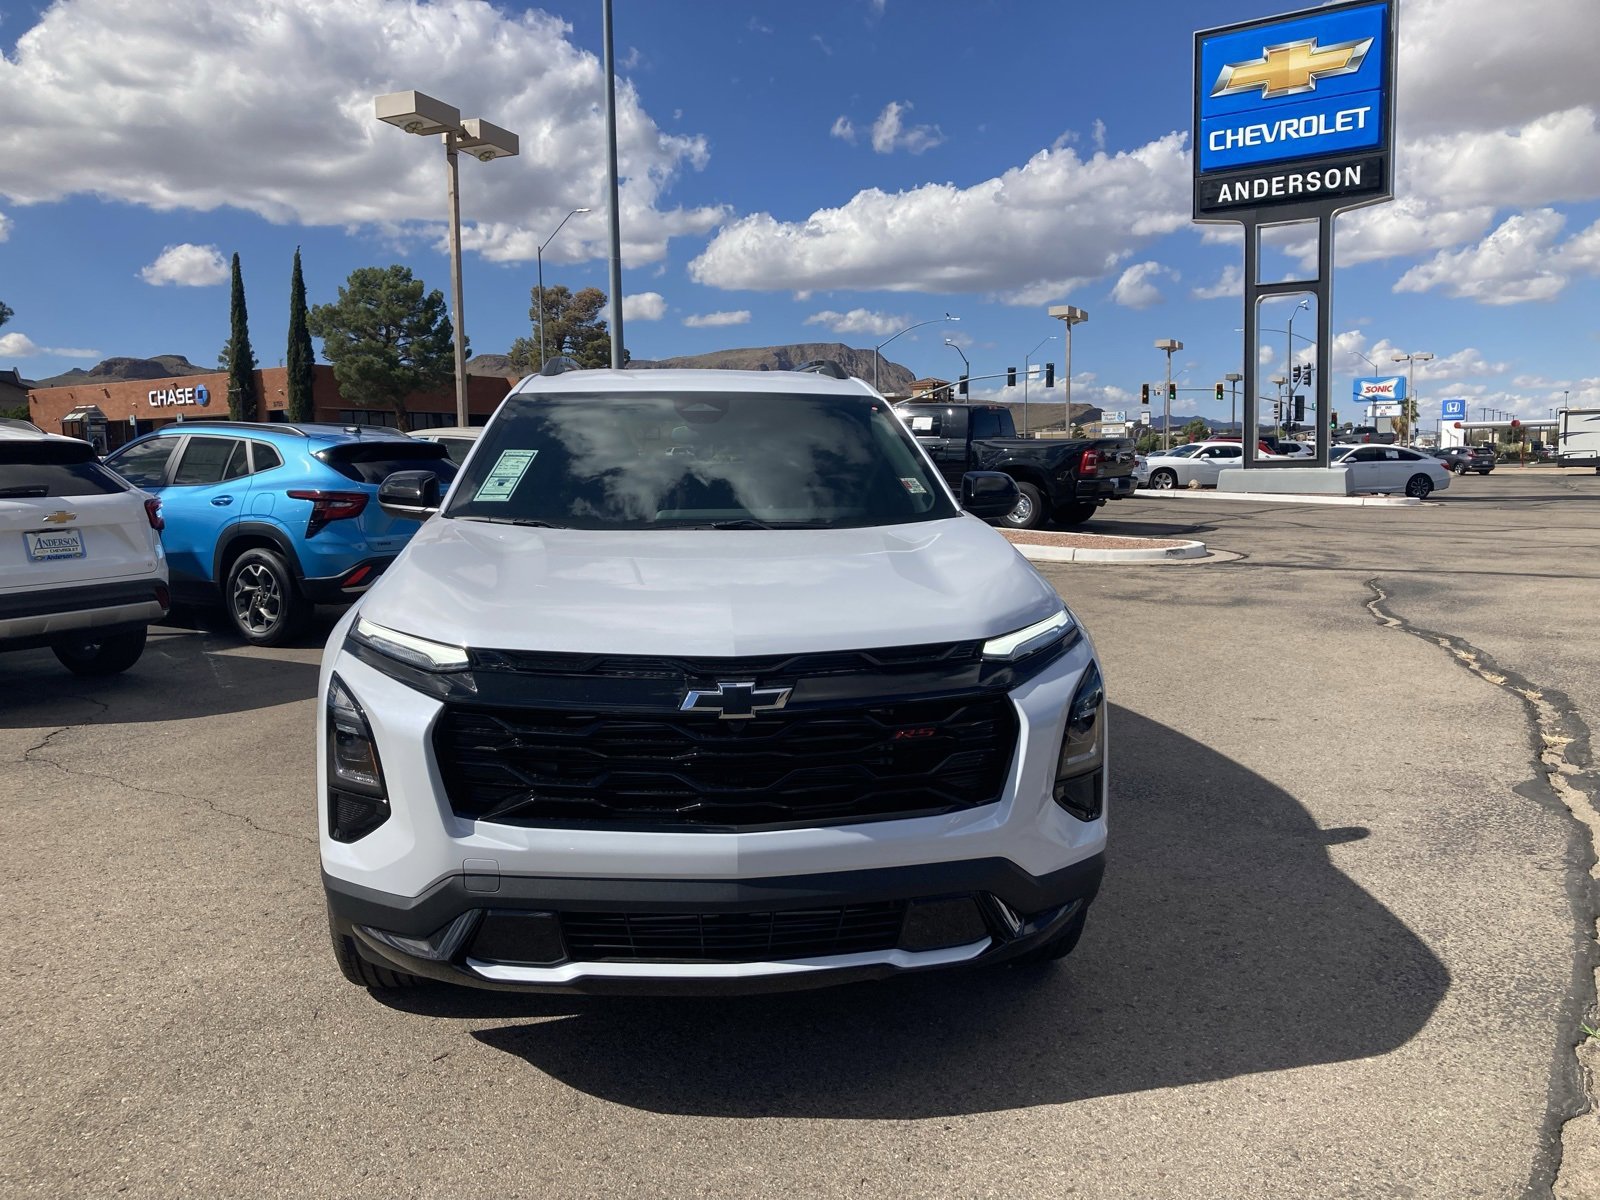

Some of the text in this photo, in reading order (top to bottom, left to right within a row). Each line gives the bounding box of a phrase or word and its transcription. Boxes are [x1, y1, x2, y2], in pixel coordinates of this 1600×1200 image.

[1209, 106, 1371, 151] CHEVROLET
[1217, 165, 1361, 203] ANDERSON
[148, 387, 194, 406] CHASE
[1364, 385, 1393, 394] SONIC
[33, 537, 80, 555] ANDERSON
